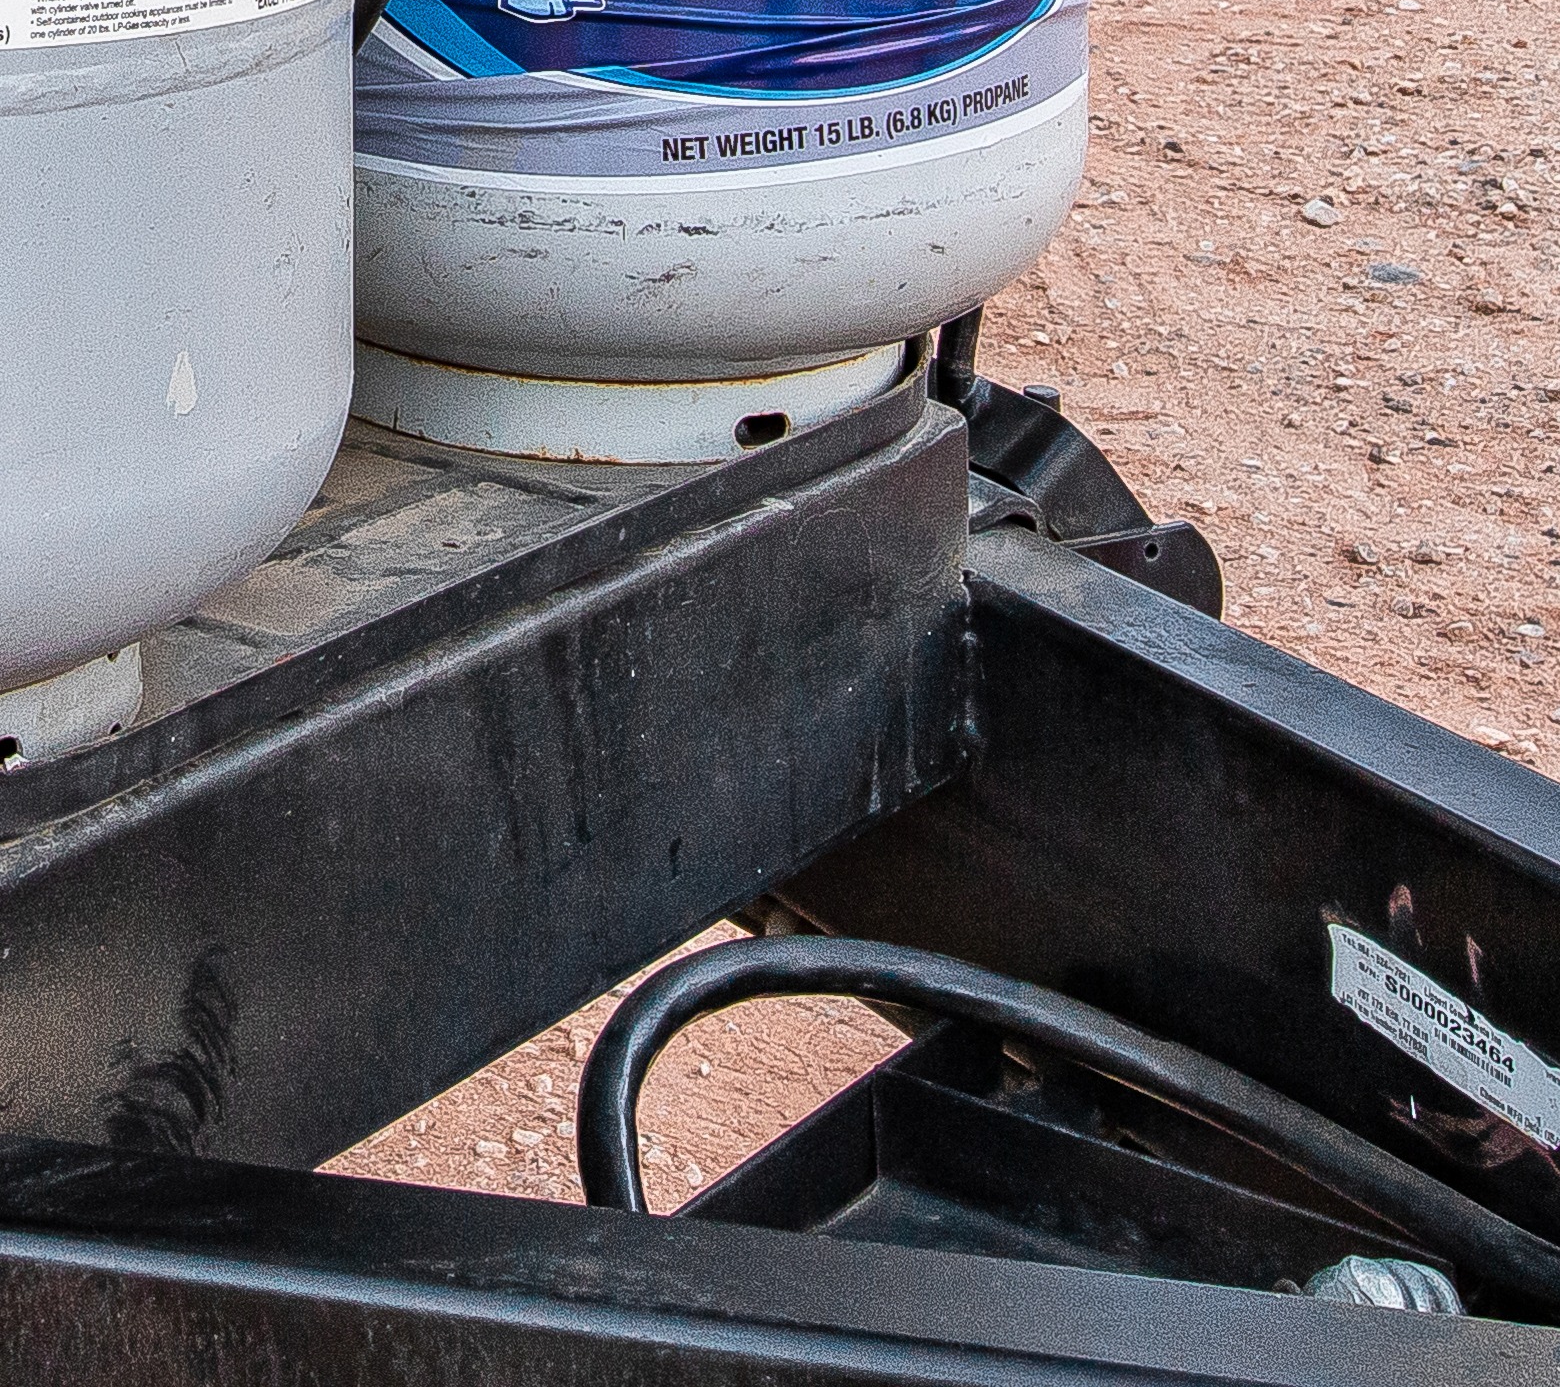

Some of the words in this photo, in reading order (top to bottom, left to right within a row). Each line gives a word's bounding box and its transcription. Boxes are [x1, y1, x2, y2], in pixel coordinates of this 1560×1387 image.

[662, 136, 709, 162] NET
[716, 126, 807, 158] WEIGHT
[814, 123, 841, 147] 15
[847, 117, 880, 142] LB.
[886, 107, 923, 140] (6.8
[927, 99, 958, 126] KG)
[963, 75, 1029, 117] PROPANE
[1384, 973, 1517, 1073] S000023464
